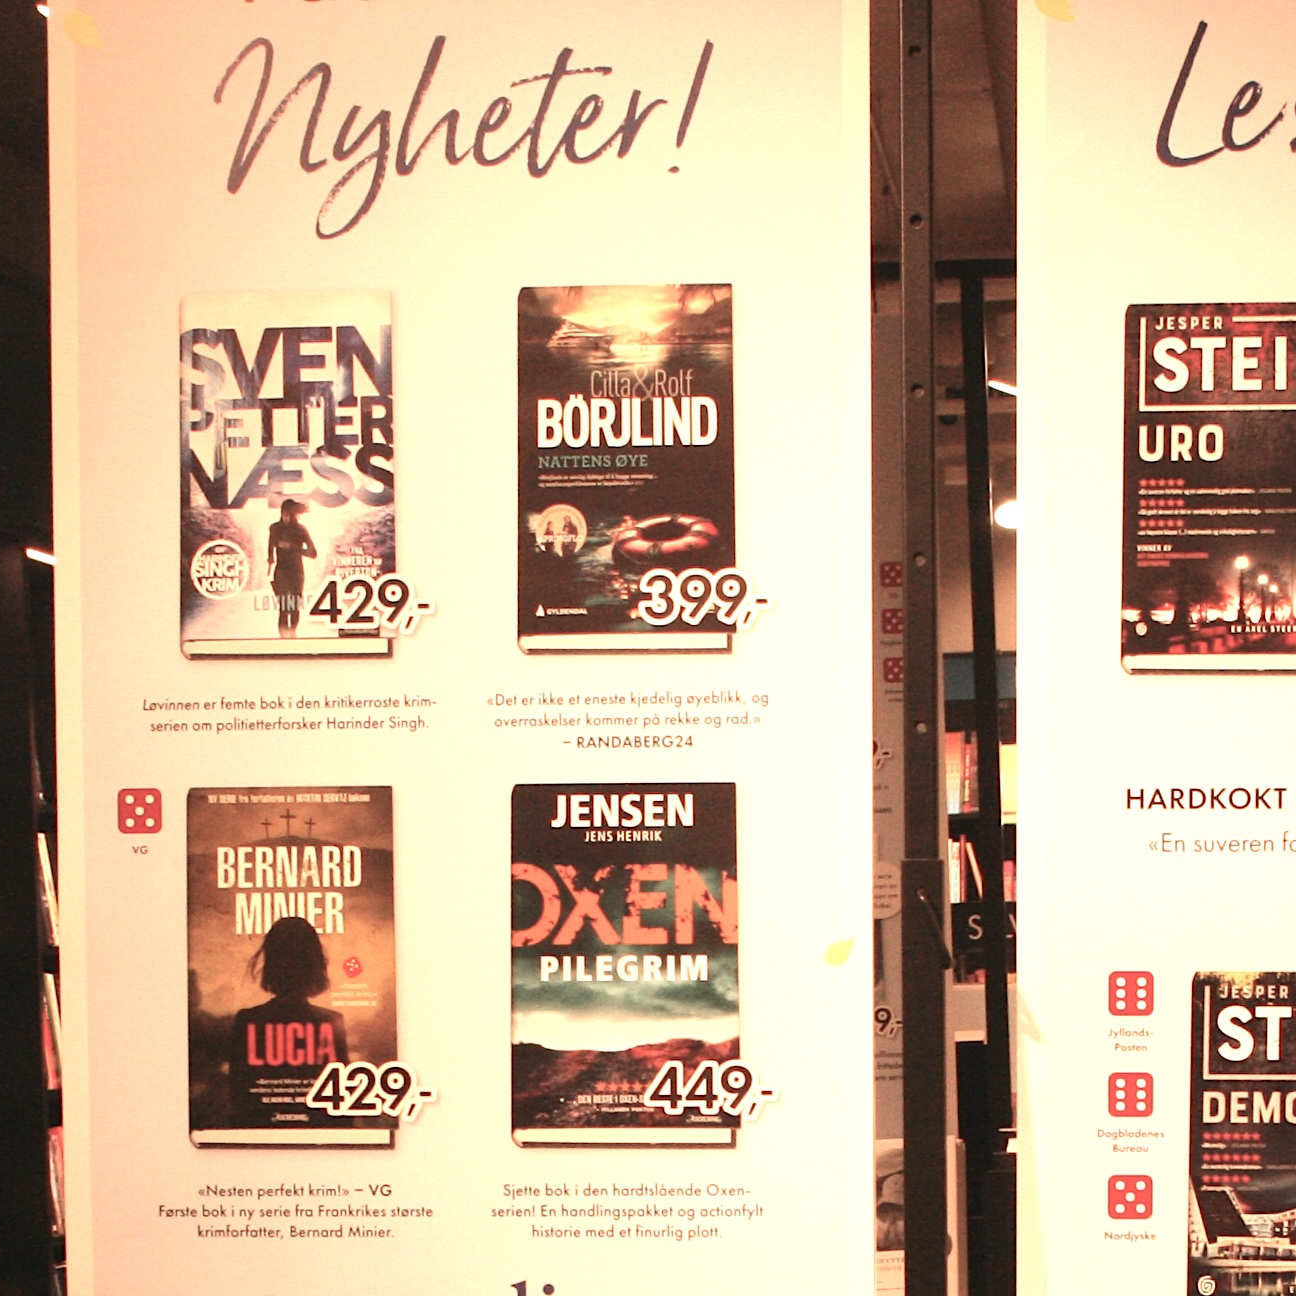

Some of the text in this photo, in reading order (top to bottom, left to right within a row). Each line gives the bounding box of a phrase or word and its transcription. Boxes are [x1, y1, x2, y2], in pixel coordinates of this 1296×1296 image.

[213, 34, 714, 240] Nyheter!
[537, 394, 718, 448] BÖRJLIND
[1138, 423, 1225, 462] URO
[538, 454, 649, 469] NATTENS ØYE
[309, 578, 430, 630] 429,-
[643, 574, 769, 625] 399,-
[576, 735, 693, 749] RANDABERG24
[551, 794, 694, 828] JENSEN
[1126, 787, 1287, 810] HARDKOKT
[585, 830, 662, 843] JENS HENRIK
[1194, 839, 1274, 853] suveren
[217, 846, 362, 889] BERNARD
[540, 955, 709, 982] PILEGRIM
[247, 1022, 336, 1066] LUCIA
[311, 1066, 433, 1118] 429,-
[649, 1065, 774, 1115] 449,-
[257, 1183, 305, 1201] perfekt
[368, 1183, 392, 1197] VG
[197, 1224, 394, 1240] krimforfatter, Bernard Minier.
